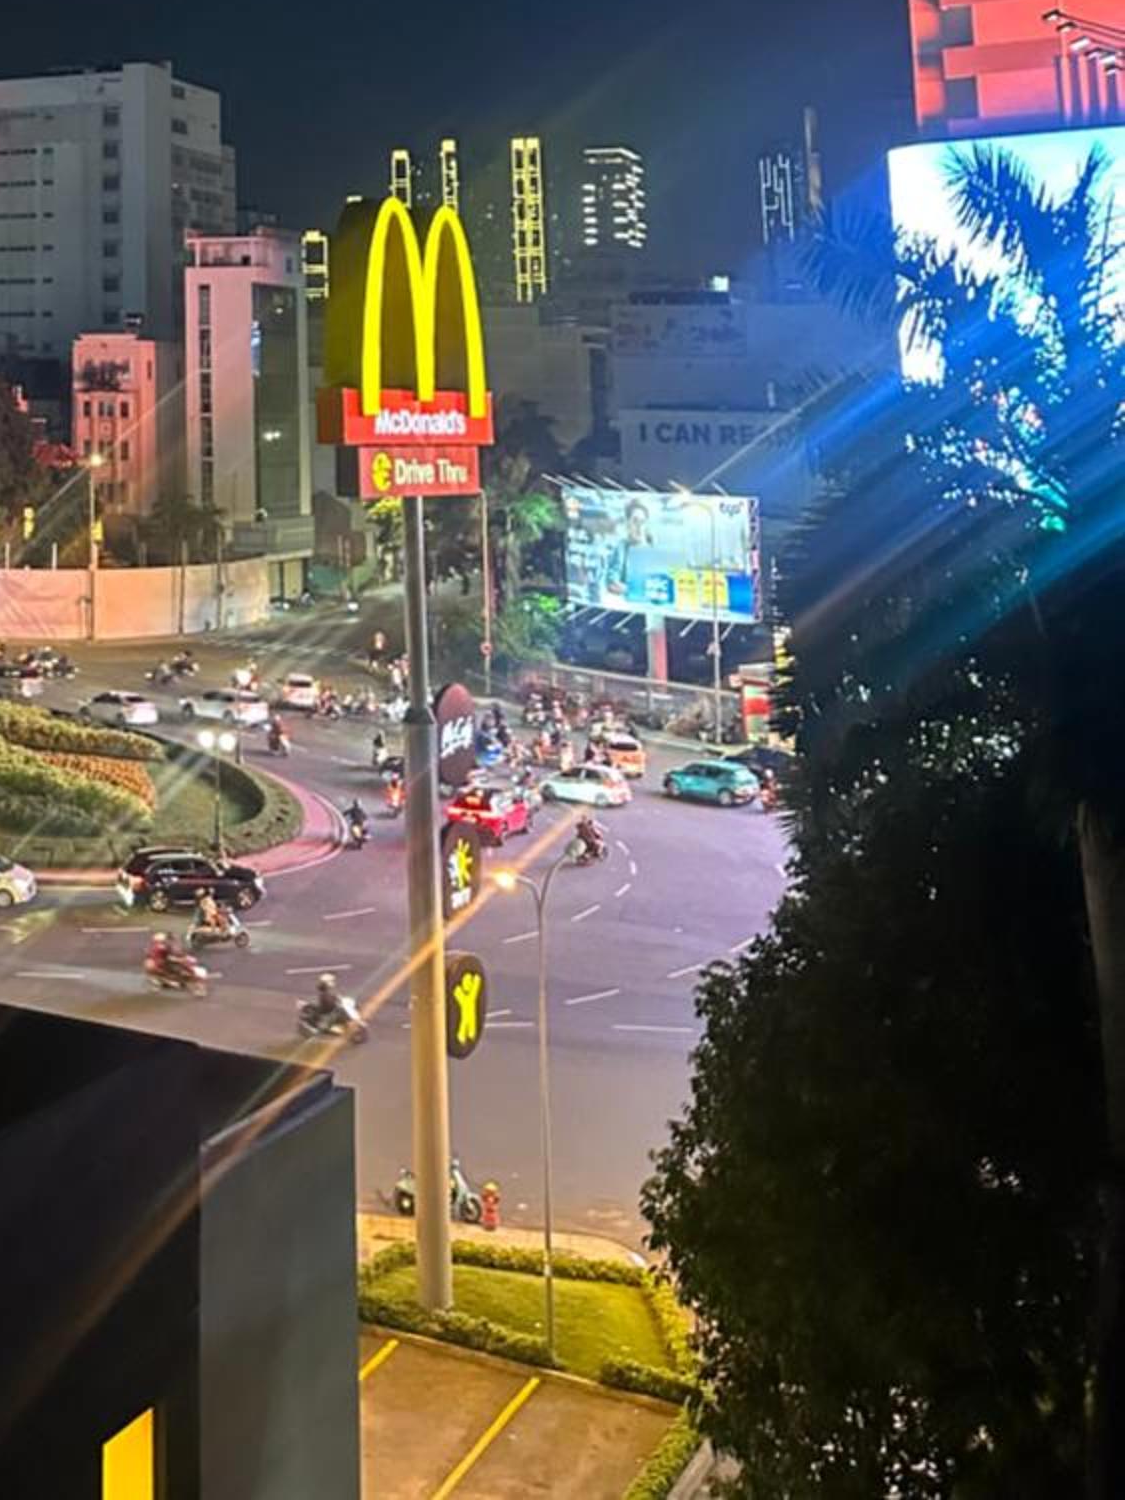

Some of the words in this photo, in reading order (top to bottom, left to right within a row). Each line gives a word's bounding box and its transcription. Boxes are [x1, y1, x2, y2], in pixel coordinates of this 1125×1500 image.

[374, 408, 465, 436] McDonald's
[639, 422, 647, 442] I
[655, 422, 711, 444] CAN
[394, 457, 435, 485] Drive
[437, 457, 469, 484] Thru
